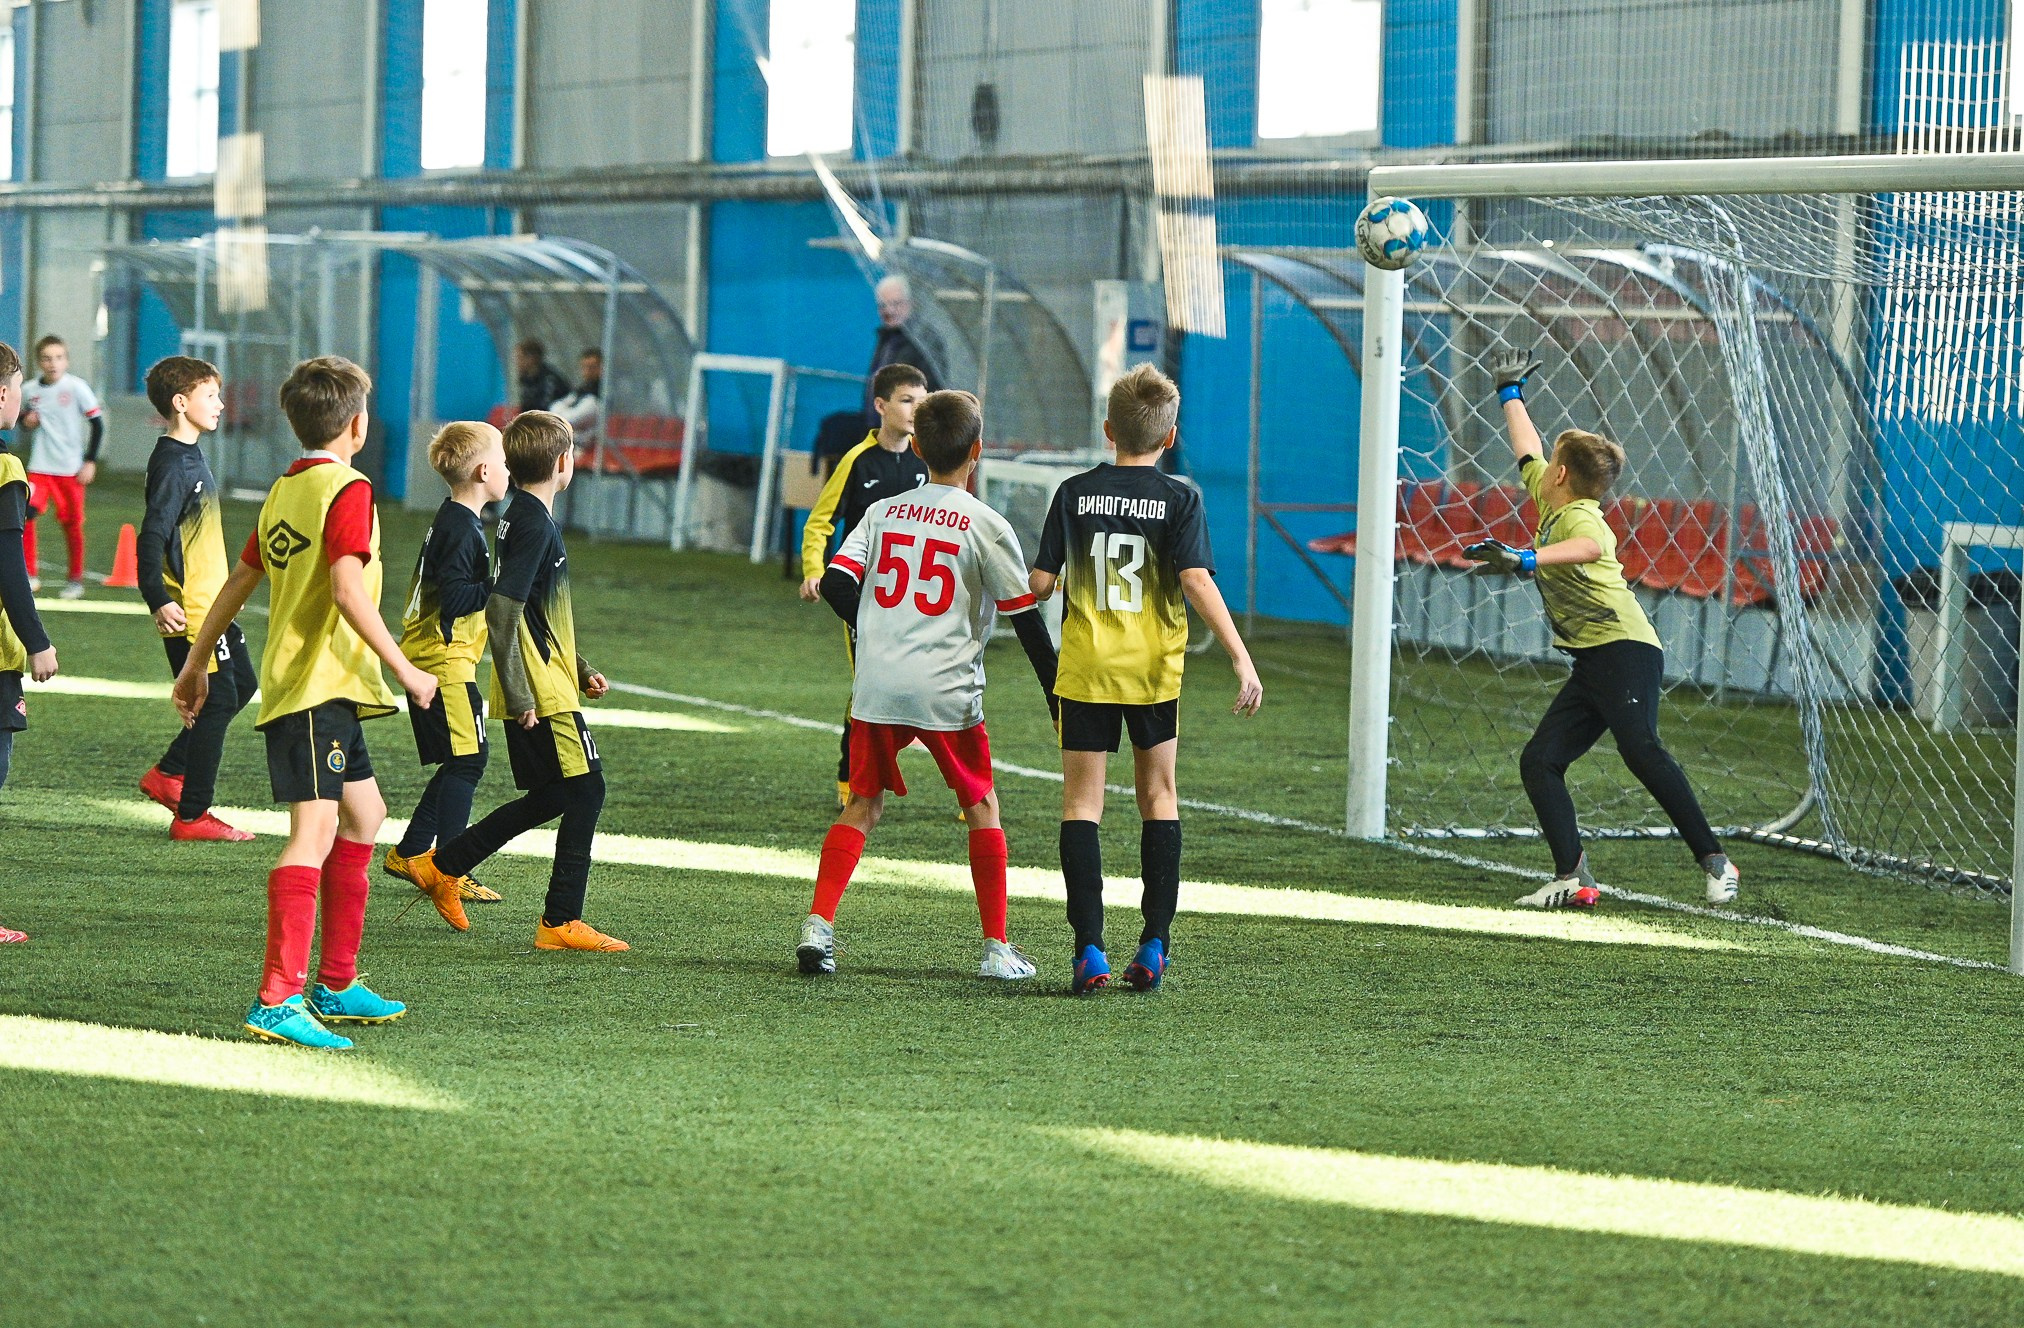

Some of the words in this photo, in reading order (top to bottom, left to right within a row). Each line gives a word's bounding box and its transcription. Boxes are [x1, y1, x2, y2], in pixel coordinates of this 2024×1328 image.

[885, 503, 971, 532] РЕМИЗОВ
[1077, 495, 1167, 520] ВИНОГРАДОВ
[874, 531, 961, 617] 55
[1089, 531, 1146, 613] 13
